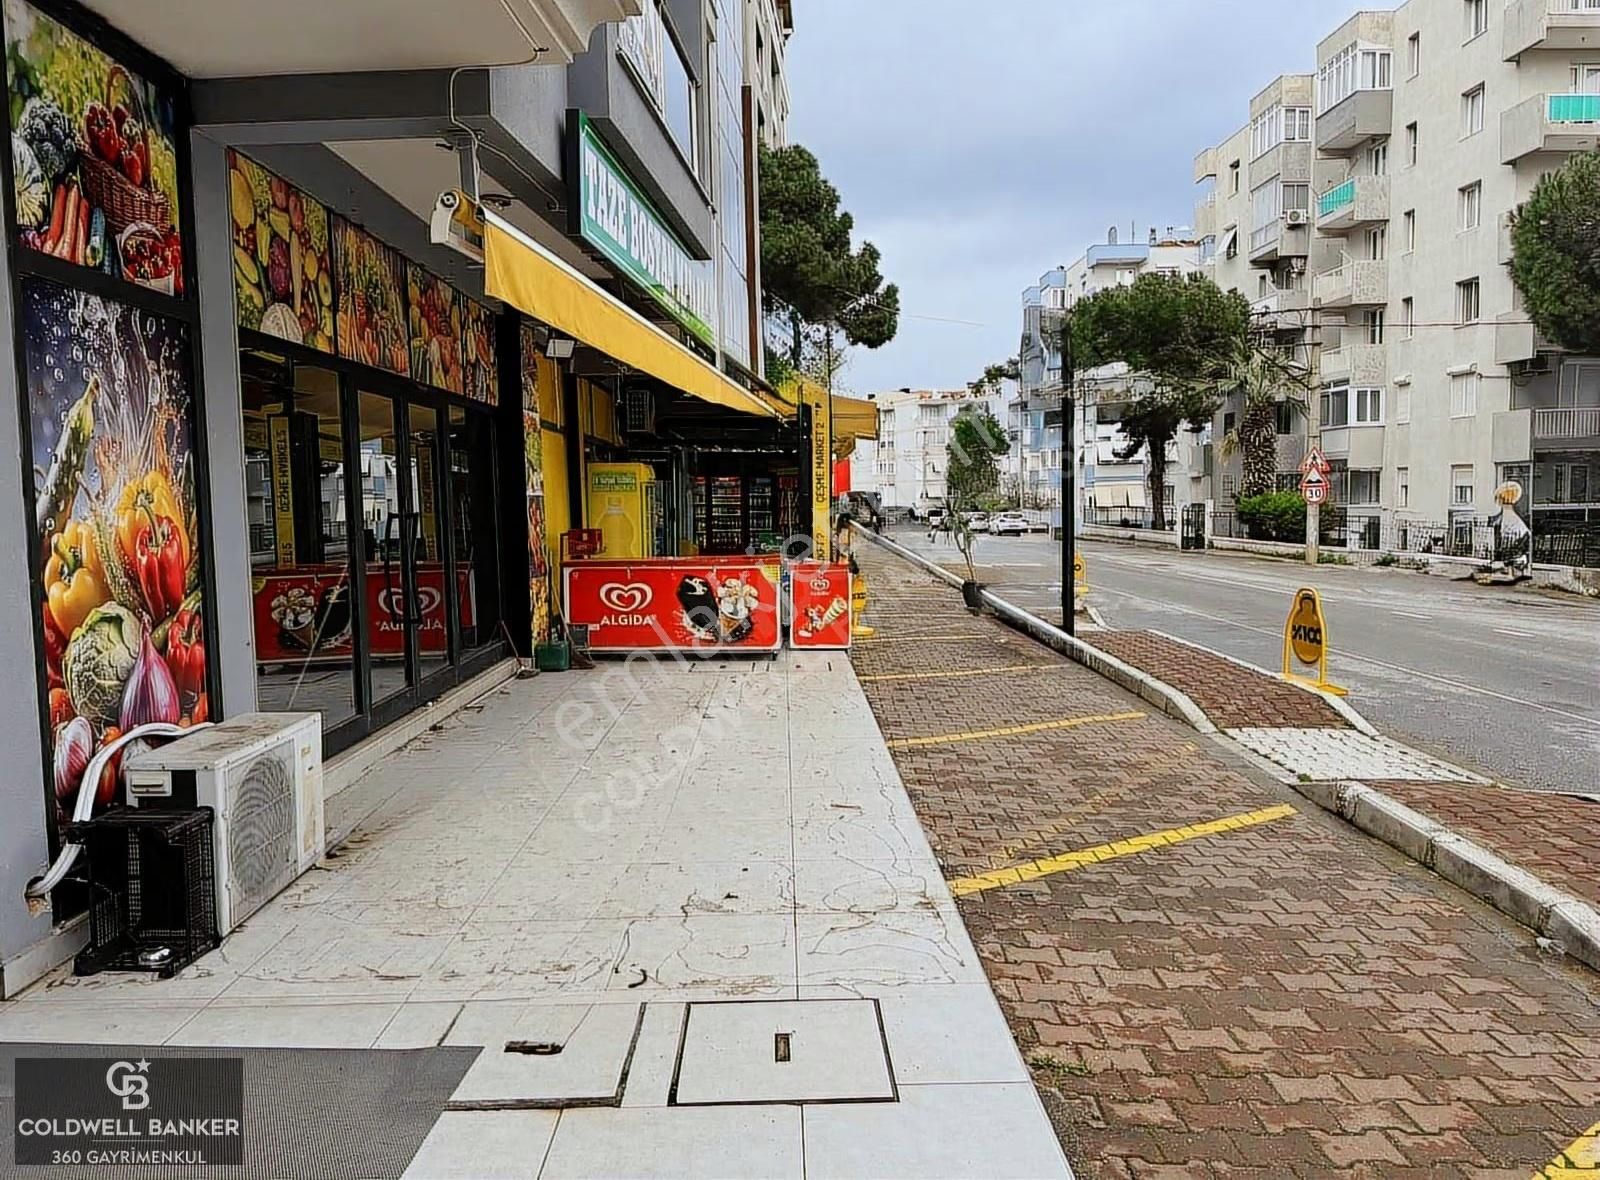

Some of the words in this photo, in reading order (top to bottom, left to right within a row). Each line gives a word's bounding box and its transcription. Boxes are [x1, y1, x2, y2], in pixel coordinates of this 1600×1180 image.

[585, 145, 628, 251] TAZE
[816, 433, 825, 470] MARKET
[1308, 489, 1321, 499] 30
